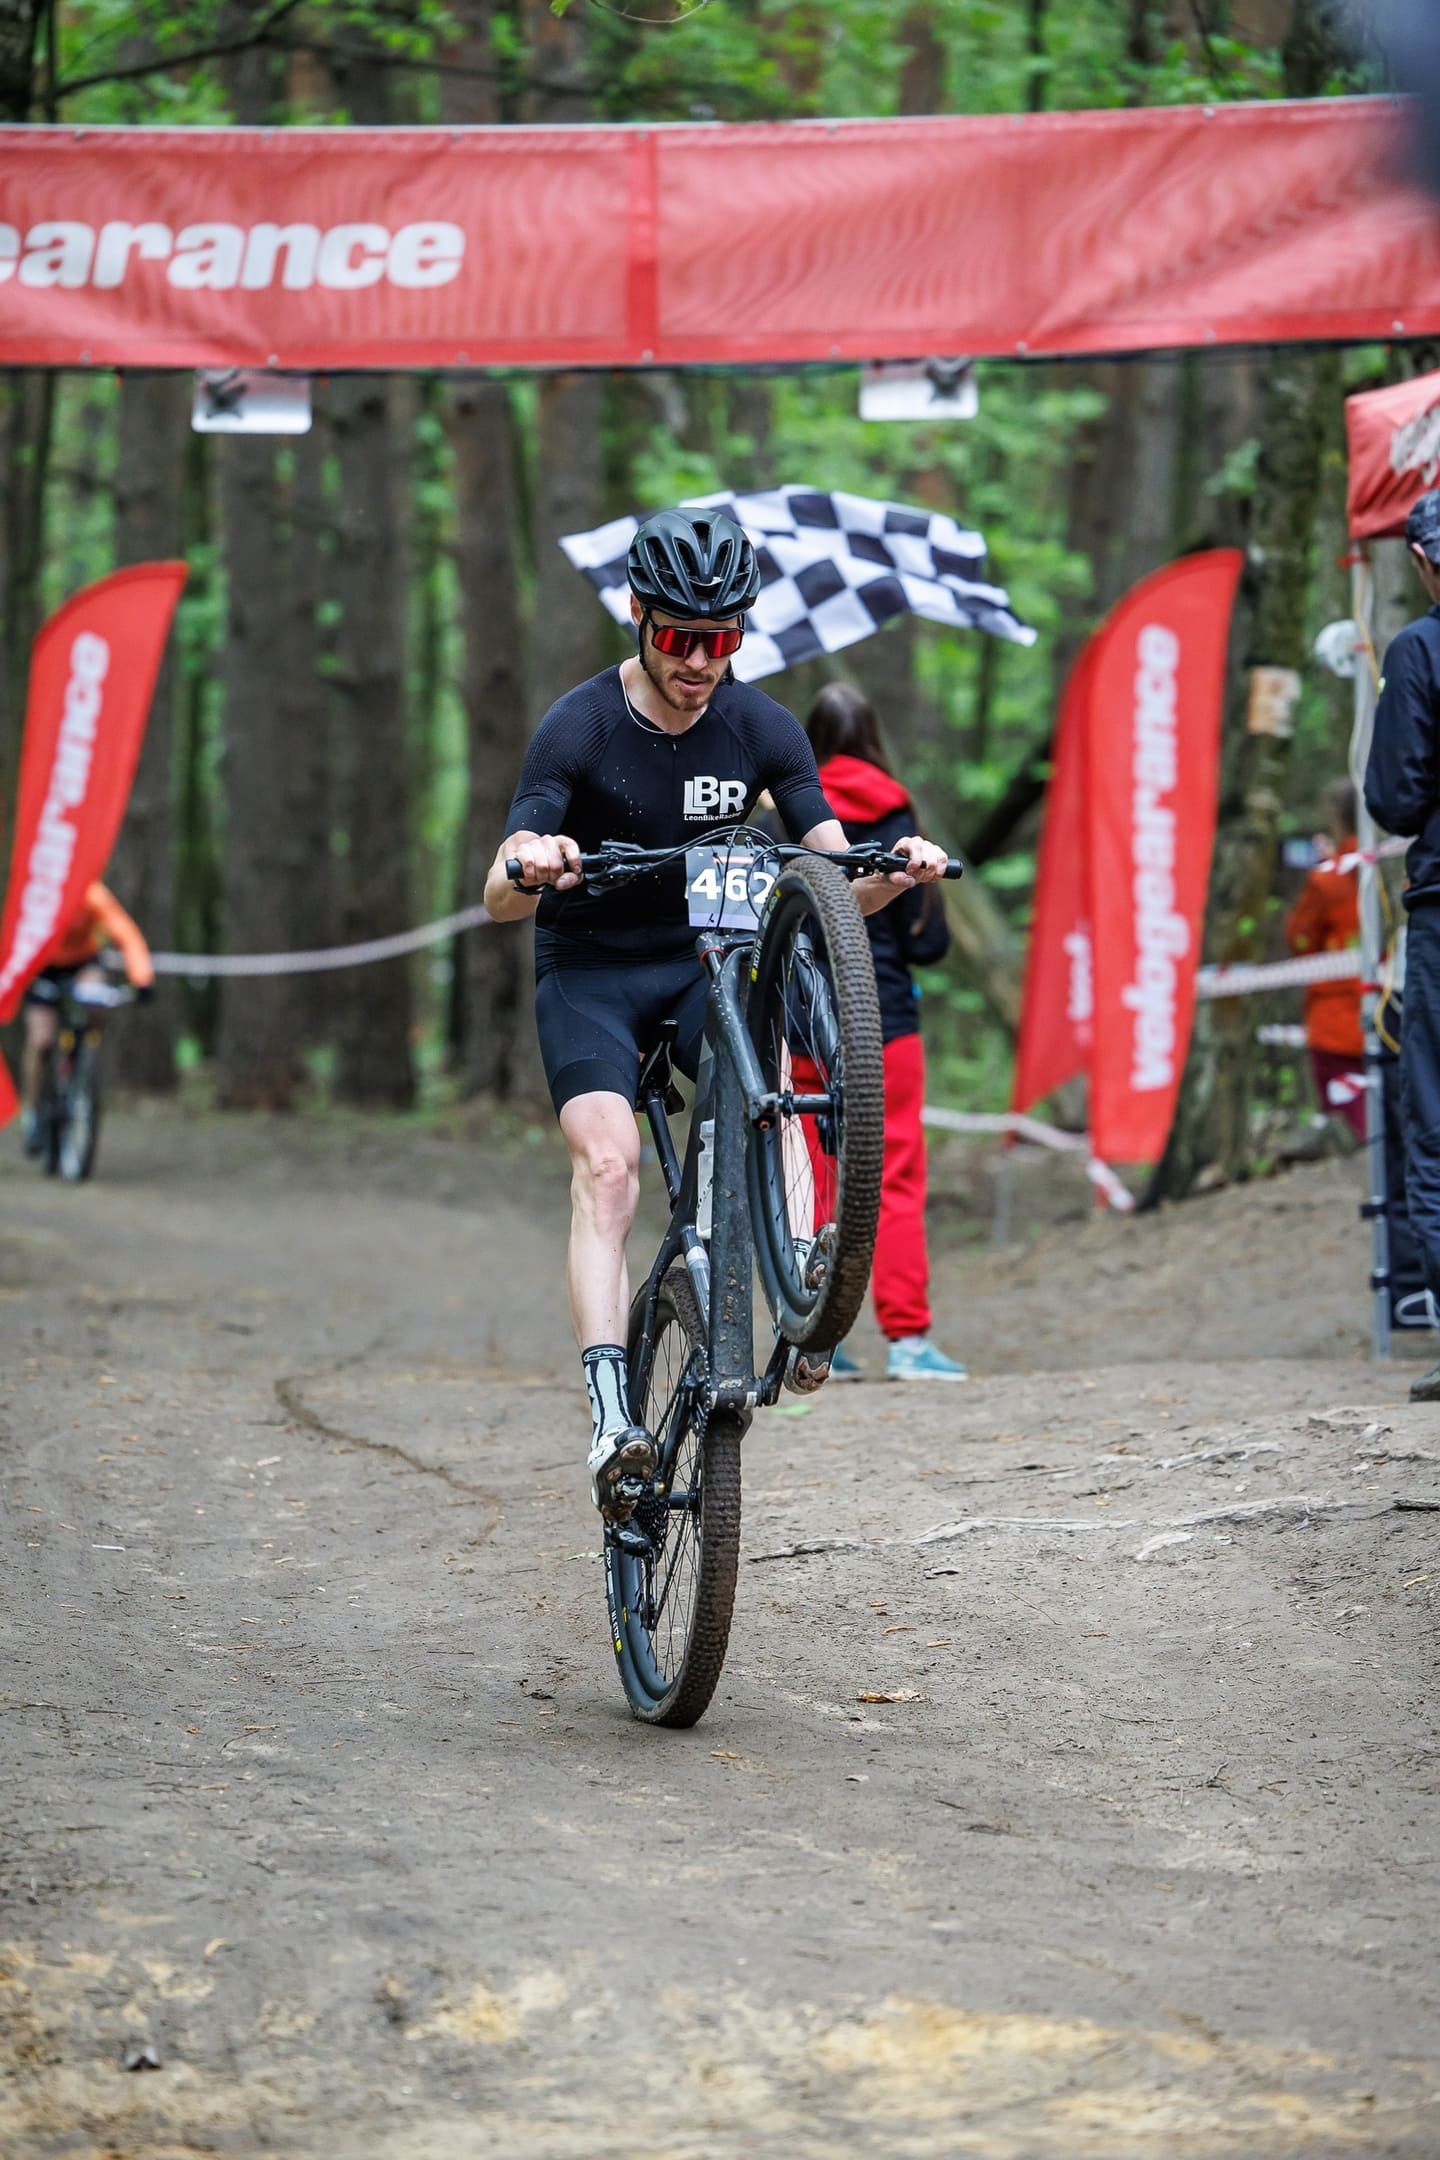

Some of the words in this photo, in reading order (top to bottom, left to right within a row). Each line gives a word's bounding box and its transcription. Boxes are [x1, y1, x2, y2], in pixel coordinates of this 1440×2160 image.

[0, 221, 466, 290] arance
[683, 776, 747, 814] LBR
[1123, 624, 1189, 1090] velogearance
[691, 869, 775, 904] 462
